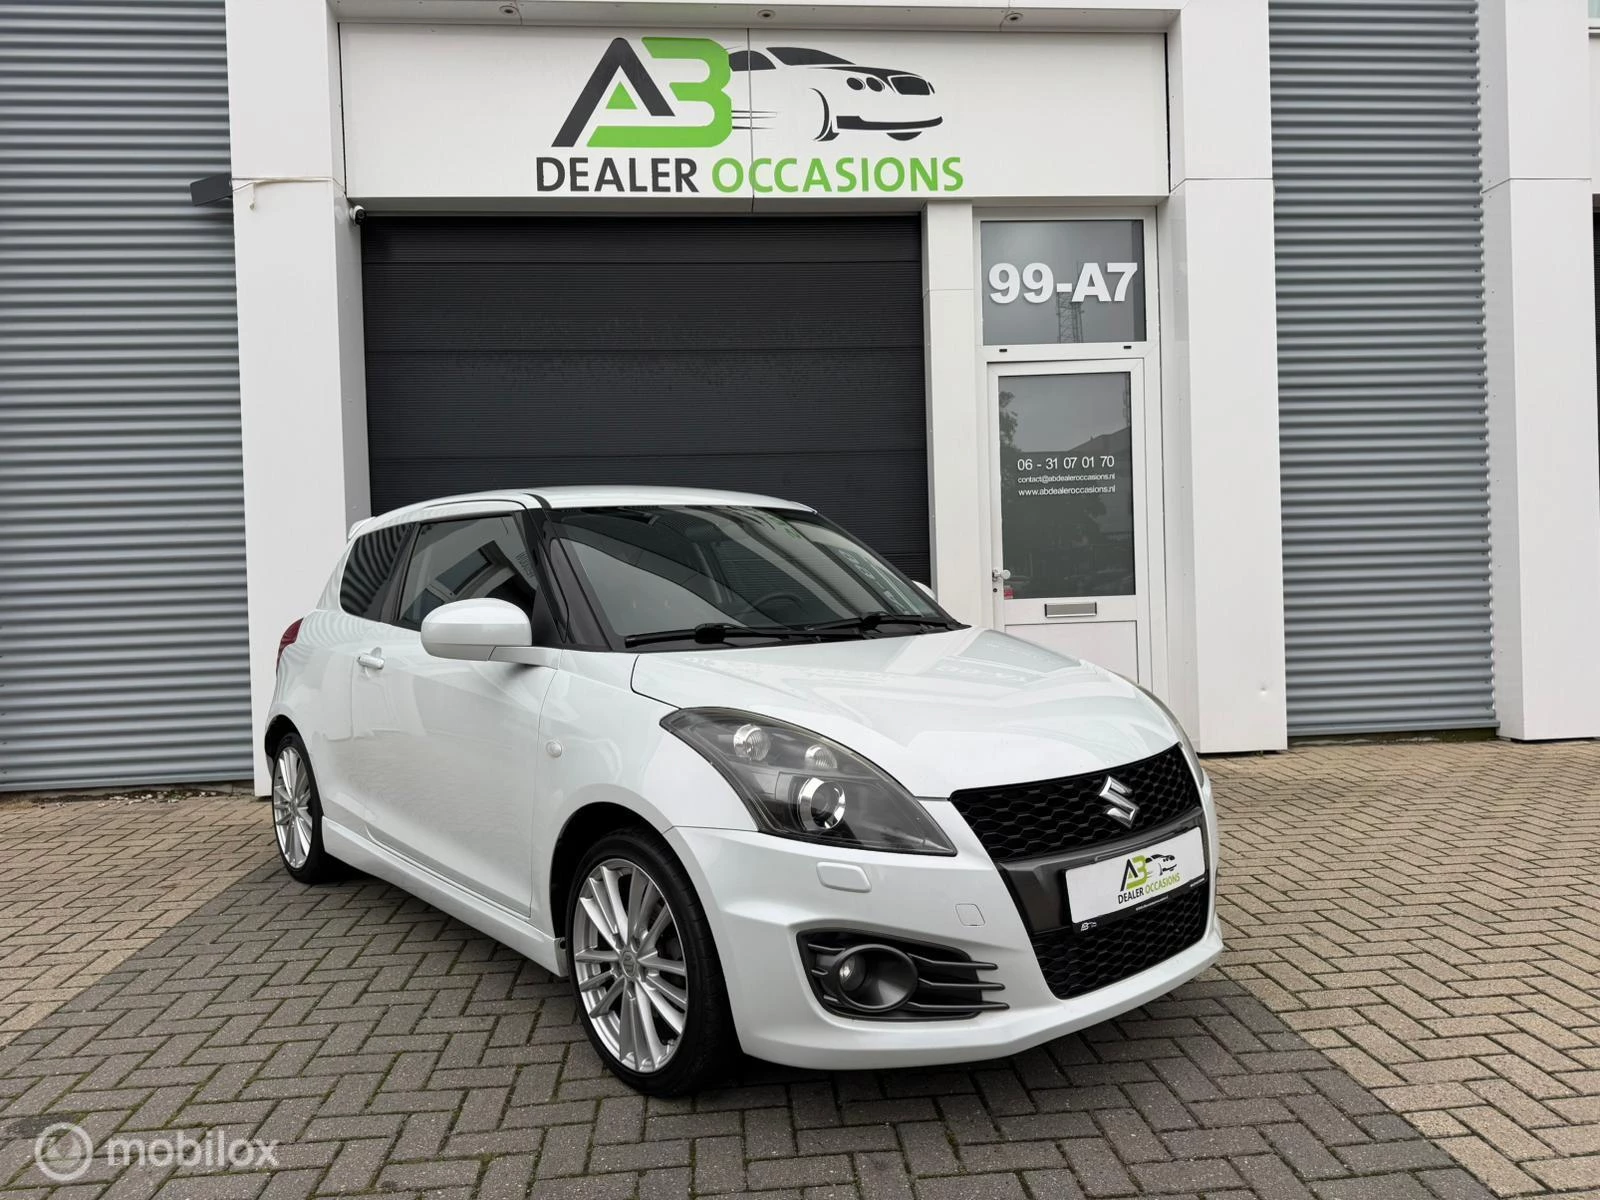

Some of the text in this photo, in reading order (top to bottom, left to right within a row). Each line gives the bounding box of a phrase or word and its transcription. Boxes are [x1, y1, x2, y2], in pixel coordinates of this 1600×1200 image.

[536, 156, 964, 193] DEALER OCCASIONS
[988, 262, 1138, 304] 99-A7
[1017, 458, 1033, 471] 06
[1045, 457, 1058, 470] 31
[1063, 456, 1077, 469] 07
[1081, 456, 1095, 468] 01
[1100, 455, 1115, 468] 70
[1017, 473, 1115, 484] contact@abdealeroccasions.nl
[1018, 484, 1116, 496] www.abdealeroccasions.nl
[1117, 872, 1181, 904] DEALER OCCASIONS
